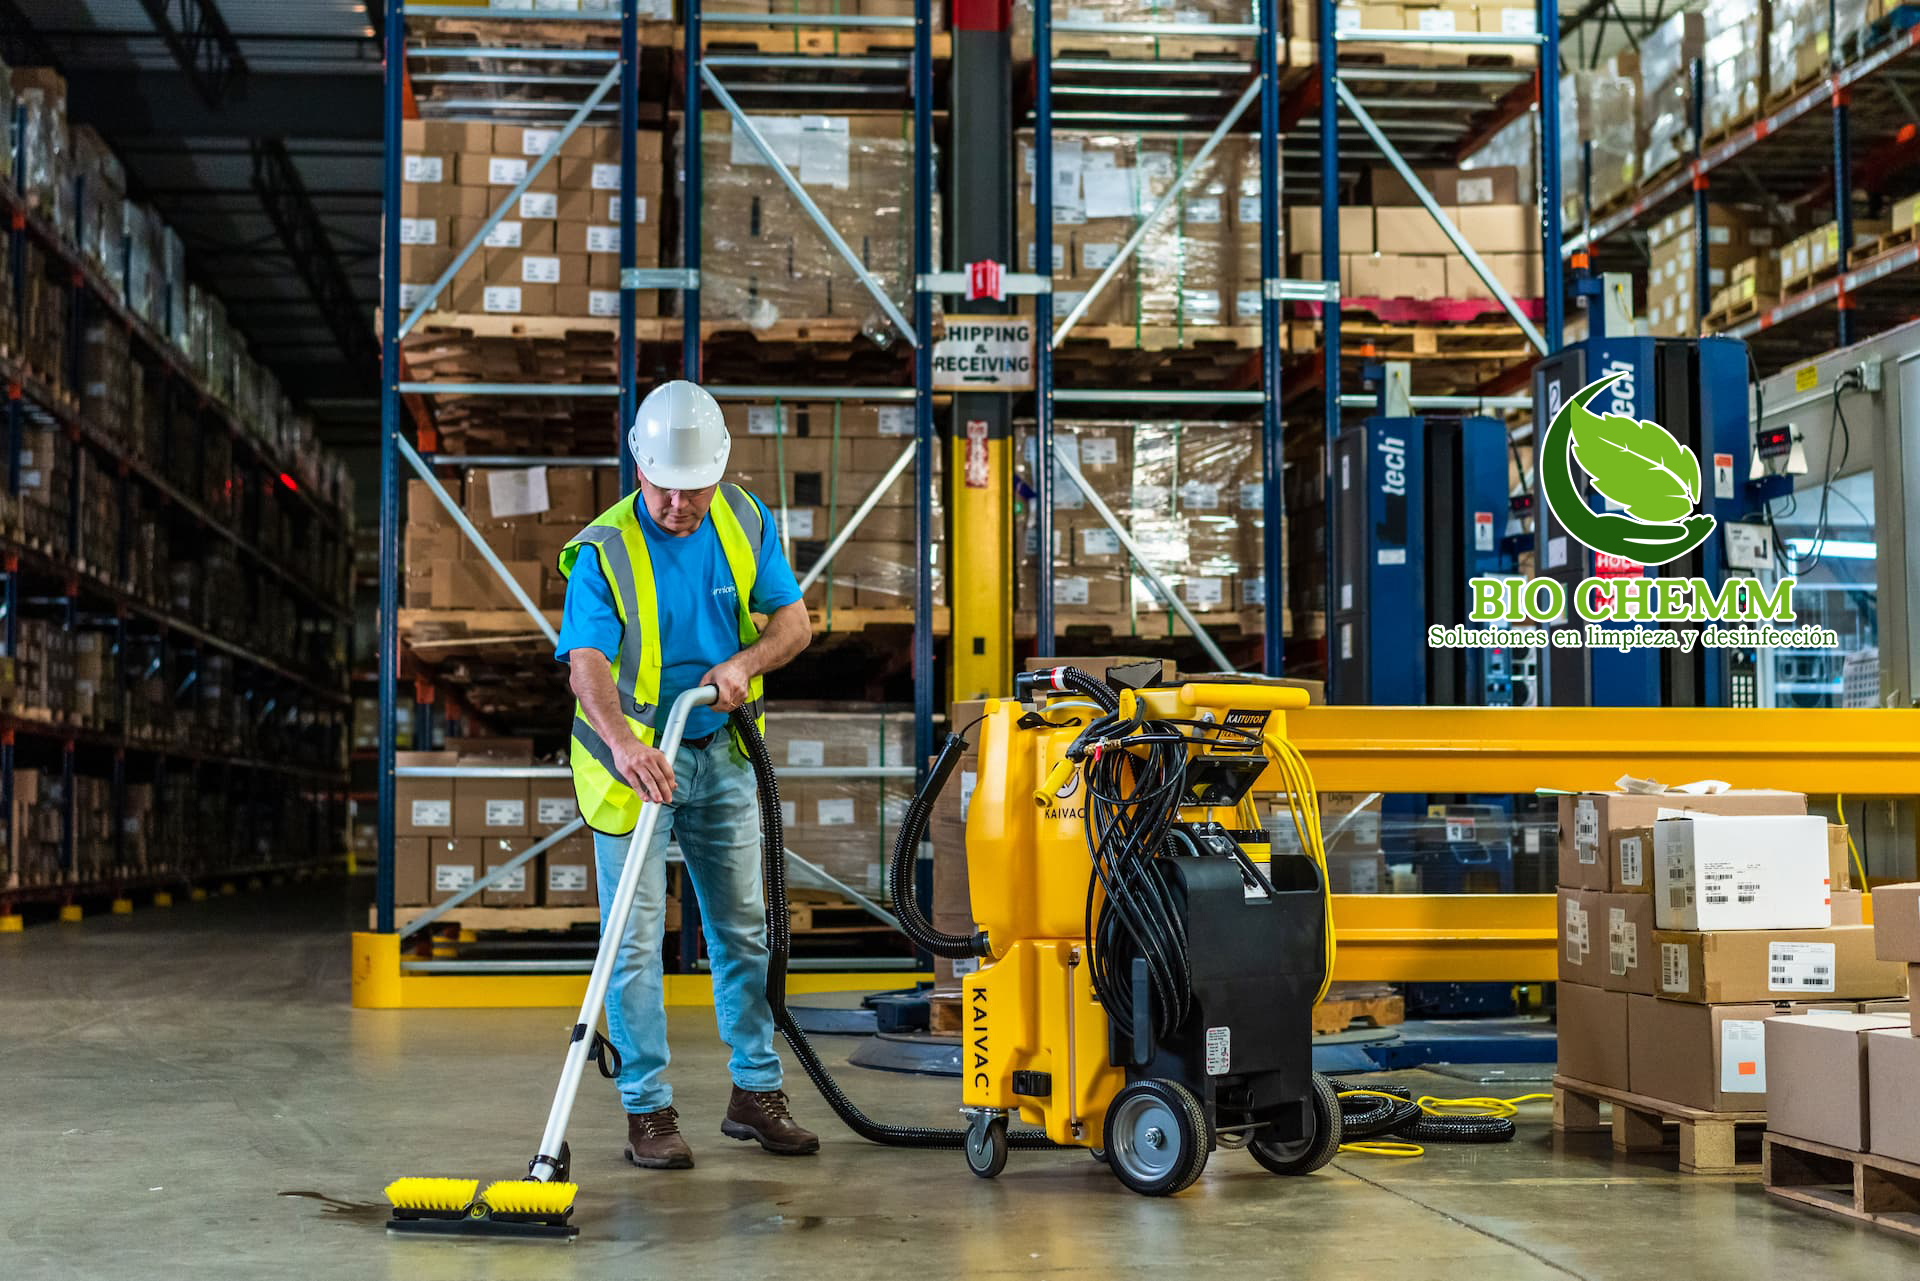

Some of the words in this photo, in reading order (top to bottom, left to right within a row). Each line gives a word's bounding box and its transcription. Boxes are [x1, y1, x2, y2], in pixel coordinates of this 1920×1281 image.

[974, 343, 987, 354] &
[935, 356, 1030, 373] RECEIVING
[1602, 360, 1635, 418] ech
[1377, 437, 1406, 496] tech
[1226, 714, 1265, 725] KAITUTOR
[1045, 808, 1085, 819] KAIVAC
[972, 988, 989, 1088] KAIVAC
